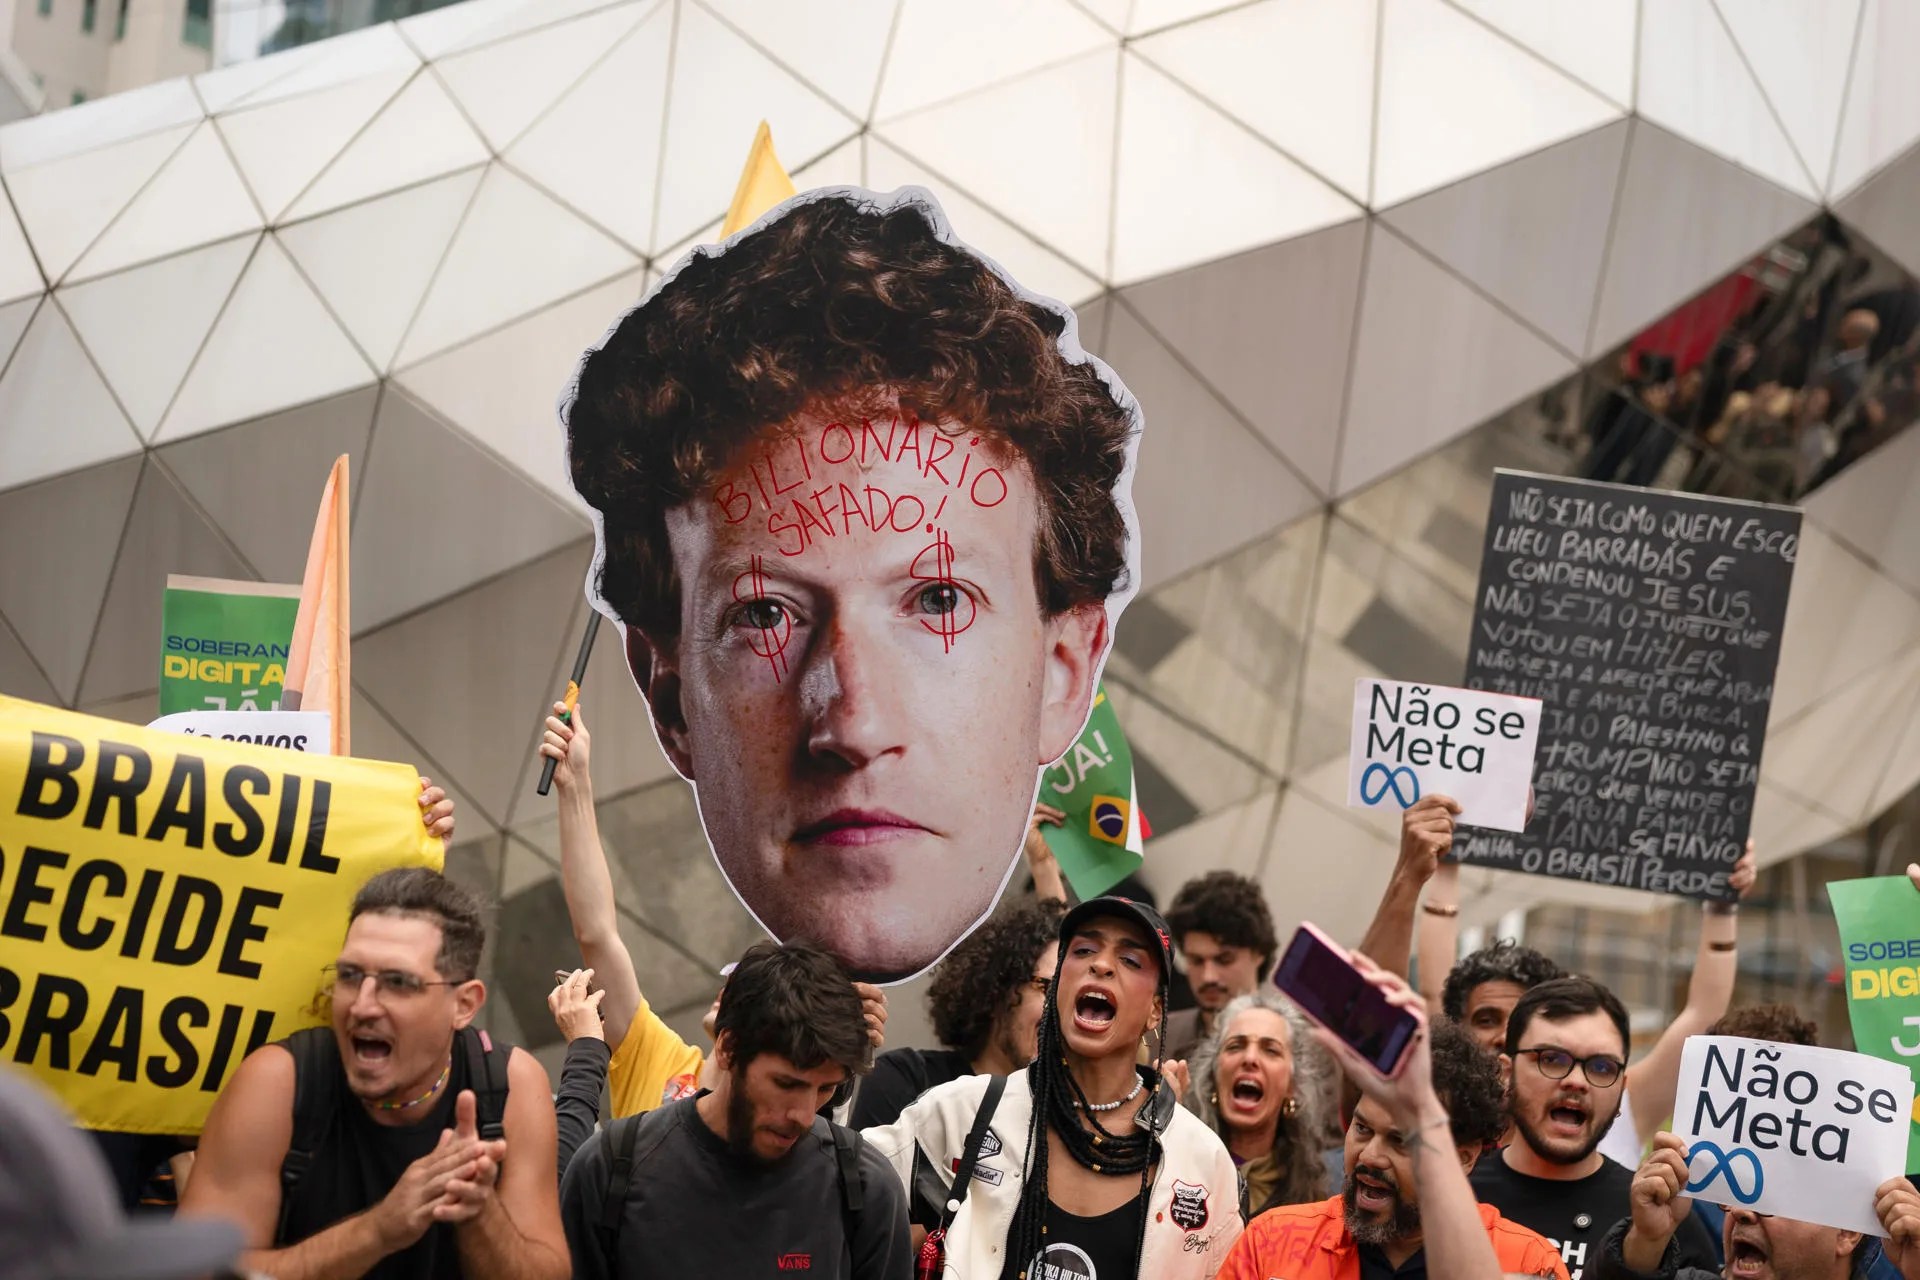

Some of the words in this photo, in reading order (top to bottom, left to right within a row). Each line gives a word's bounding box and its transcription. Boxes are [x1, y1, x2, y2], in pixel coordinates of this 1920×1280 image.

[768, 483, 948, 556] SAFADO!
[1546, 495, 1596, 528] SEJA
[1661, 510, 1732, 543] QUEM
[1493, 525, 1551, 557] LHEU
[1705, 555, 1736, 581] E
[1507, 557, 1634, 598] CONDENOU
[1484, 581, 1534, 617] NÃO
[1538, 589, 1612, 628] SEJA
[1618, 603, 1638, 629] O
[164, 655, 285, 686] DIGITA
[167, 636, 288, 658] SOBERAN
[1570, 635, 1613, 662] EM
[1369, 684, 1461, 730] Não
[1473, 707, 1525, 739] se
[1581, 712, 1600, 739] O
[1366, 723, 1485, 774] Meta
[15, 731, 340, 875] BRASIL
[1645, 784, 1727, 813] VENDE
[0, 842, 283, 980] ECIDE
[1700, 1044, 1818, 1105] Não
[1833, 1079, 1897, 1124] se
[1692, 1090, 1850, 1163] Meta
[777, 1253, 812, 1270] VANS
